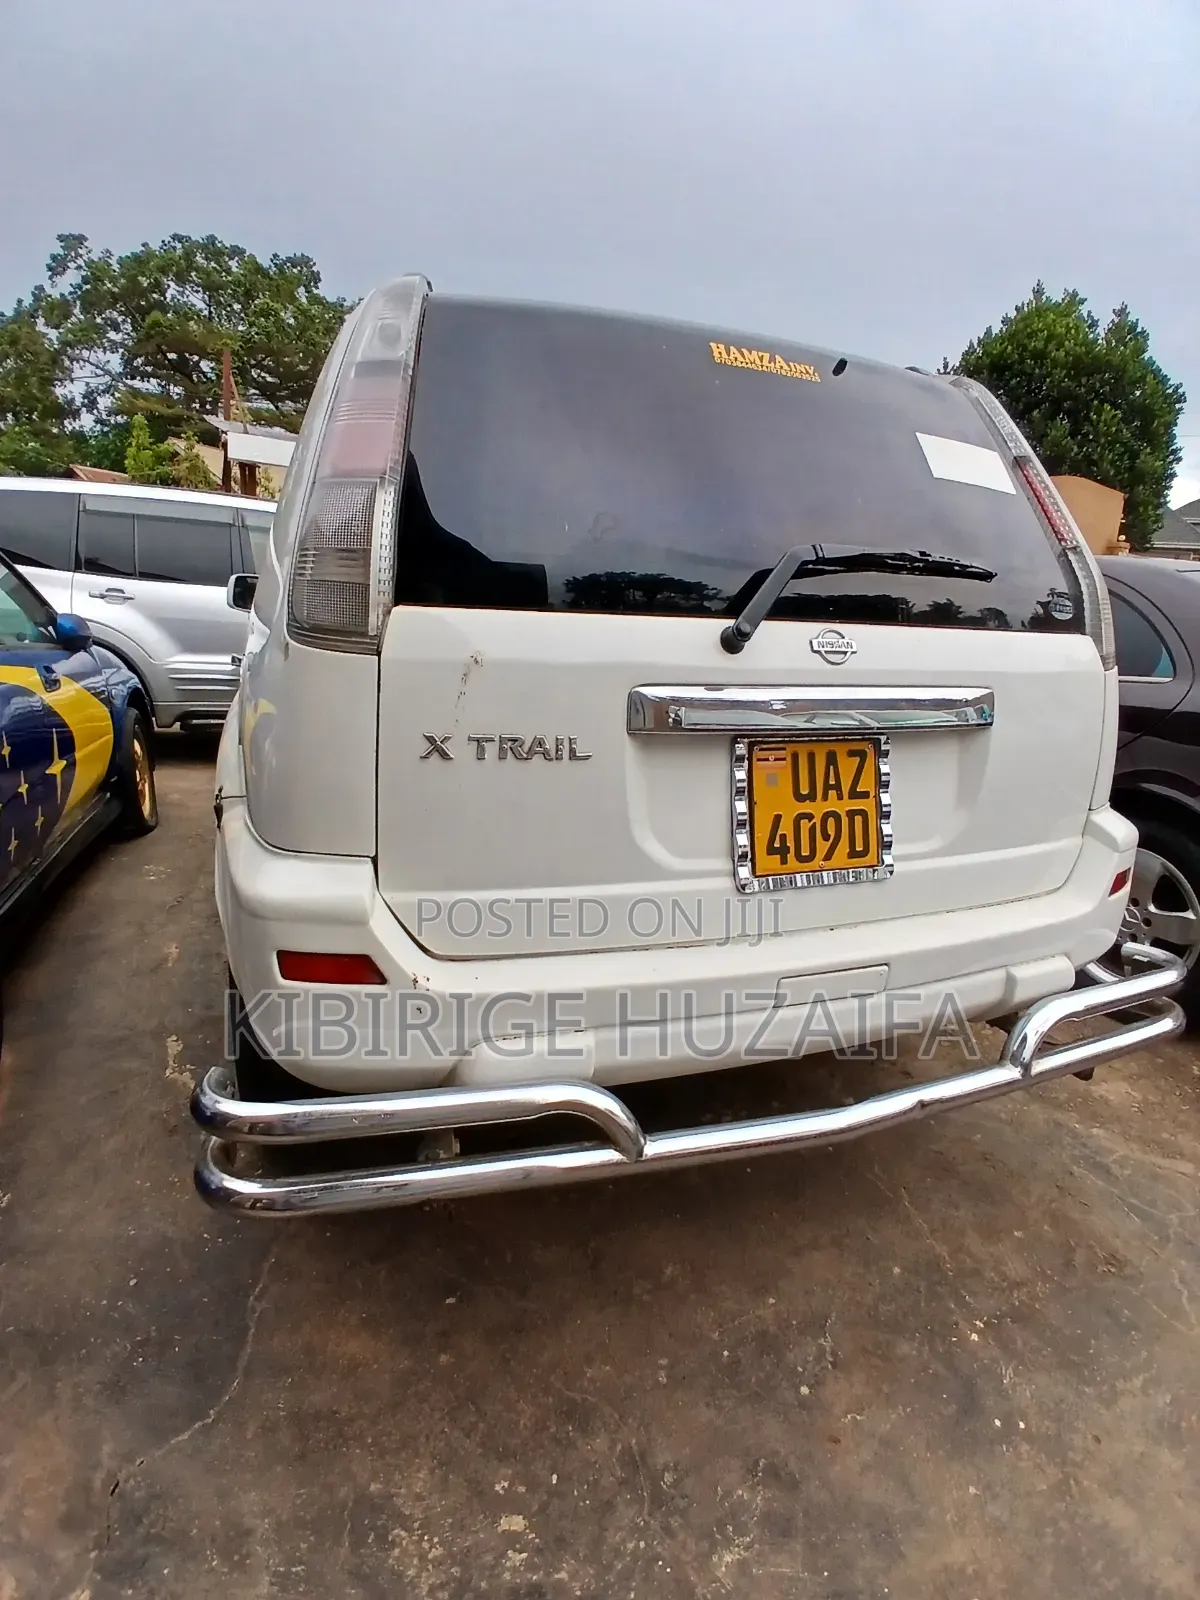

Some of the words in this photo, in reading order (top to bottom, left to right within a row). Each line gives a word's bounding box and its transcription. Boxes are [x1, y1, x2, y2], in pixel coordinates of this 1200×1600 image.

[816, 640, 854, 650] NISSAN
[419, 732, 455, 760] X
[467, 733, 593, 762] TRAIL
[790, 749, 870, 803] UAZ
[765, 807, 870, 866] 409D
